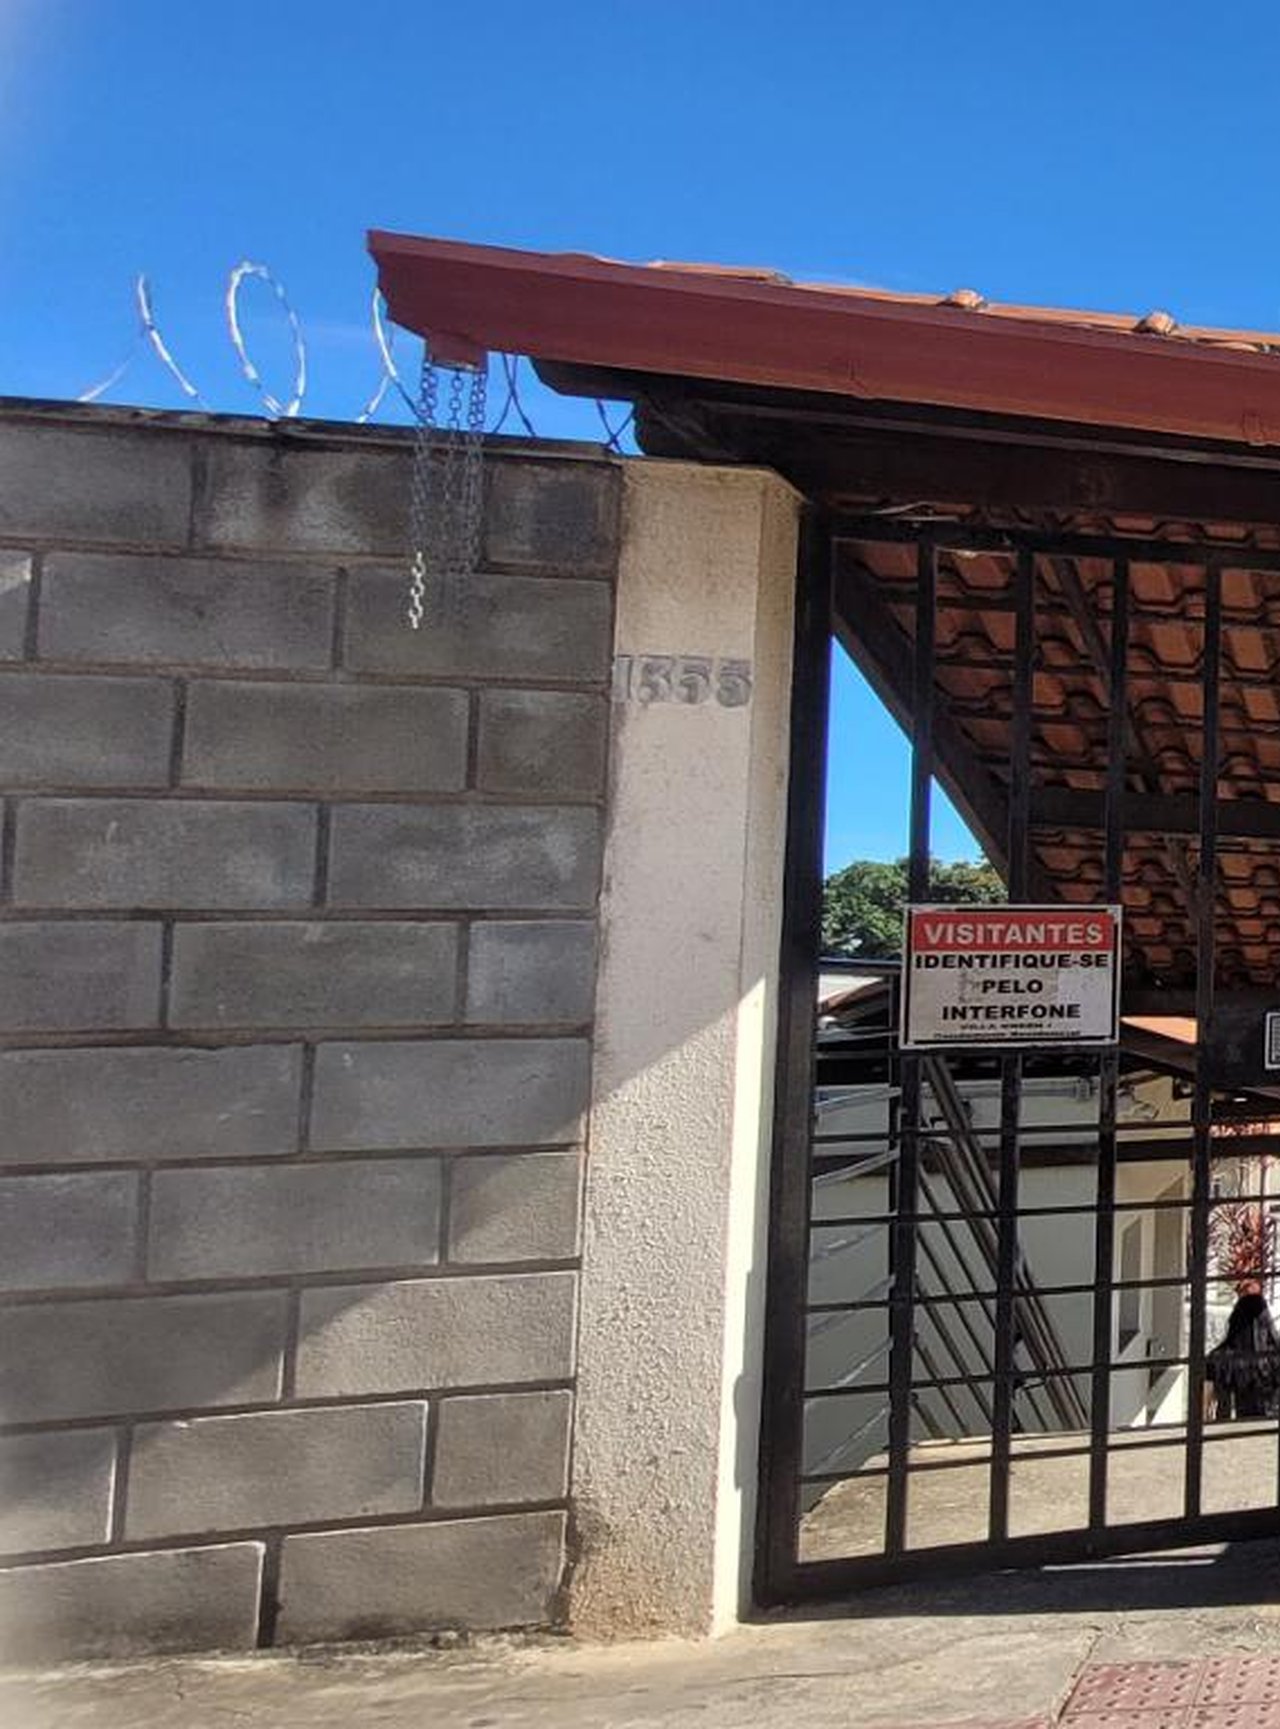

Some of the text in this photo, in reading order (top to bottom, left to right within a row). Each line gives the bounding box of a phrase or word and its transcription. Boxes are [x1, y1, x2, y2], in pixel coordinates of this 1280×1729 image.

[923, 922, 1104, 945] VISITANTES
[915, 953, 1109, 969] IDENTIFIQUE-SE
[981, 979, 1044, 994] PELO
[942, 1003, 1082, 1021] INTERFONE
